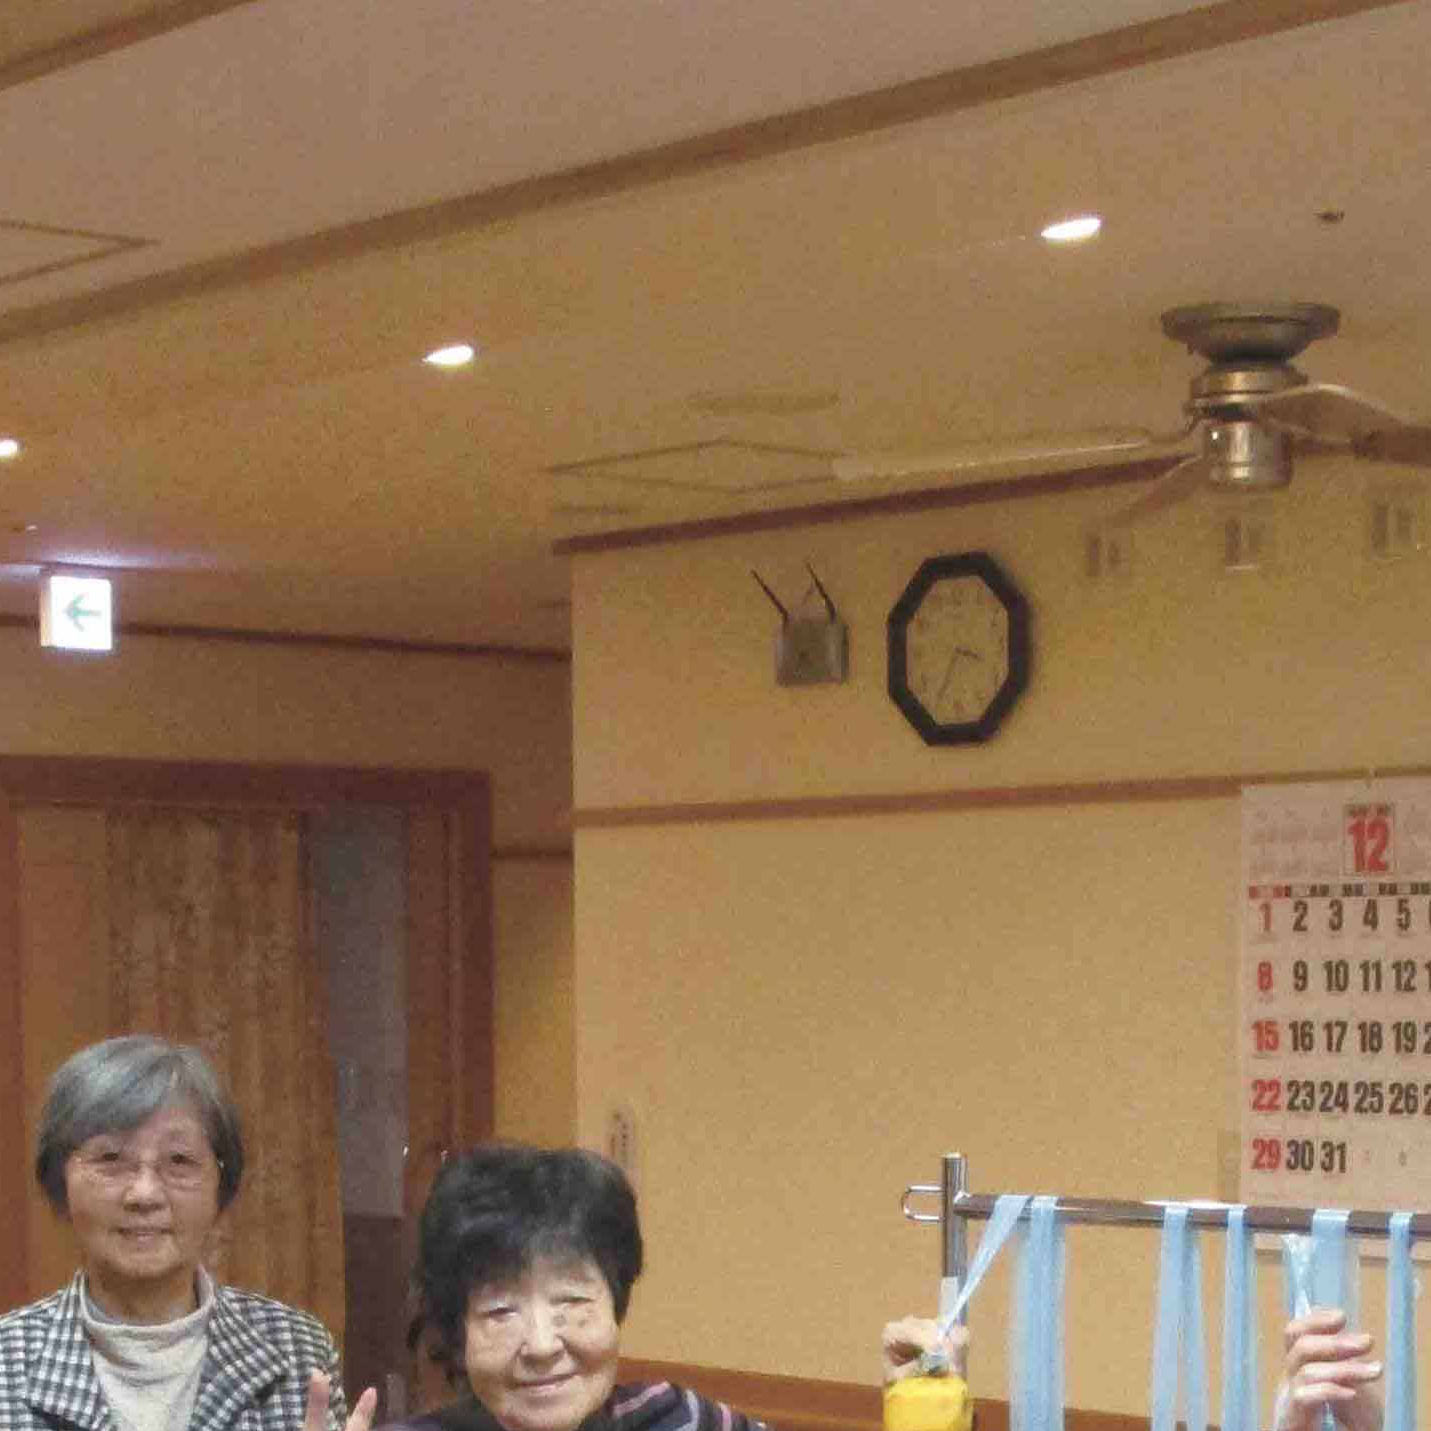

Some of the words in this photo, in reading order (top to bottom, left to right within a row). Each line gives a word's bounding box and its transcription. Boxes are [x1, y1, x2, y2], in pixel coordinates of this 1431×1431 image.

[1348, 819, 1389, 872] 12
[1260, 903, 1272, 931] 1
[1292, 901, 1308, 931] 2
[1328, 900, 1343, 931] 3
[1363, 899, 1378, 931] 4
[1397, 899, 1411, 931] 5
[1257, 961, 1273, 992] 8
[1293, 961, 1308, 992] 9
[1323, 961, 1349, 992] 10
[1359, 961, 1382, 992] 11
[1392, 960, 1417, 992] 12
[1252, 1020, 1280, 1051] 15
[1289, 1021, 1313, 1051] 16
[1323, 1021, 1348, 1052] 17
[1357, 1021, 1383, 1053] 18
[1392, 1021, 1417, 1053] 19
[1251, 1079, 1281, 1111] 22
[1286, 1080, 1314, 1111] 23
[1319, 1081, 1349, 1113] 24
[1354, 1081, 1384, 1114] 25
[1389, 1082, 1418, 1114] 26
[1251, 1138, 1281, 1169] 29
[1286, 1140, 1314, 1170] 30
[1320, 1141, 1346, 1173] 31
